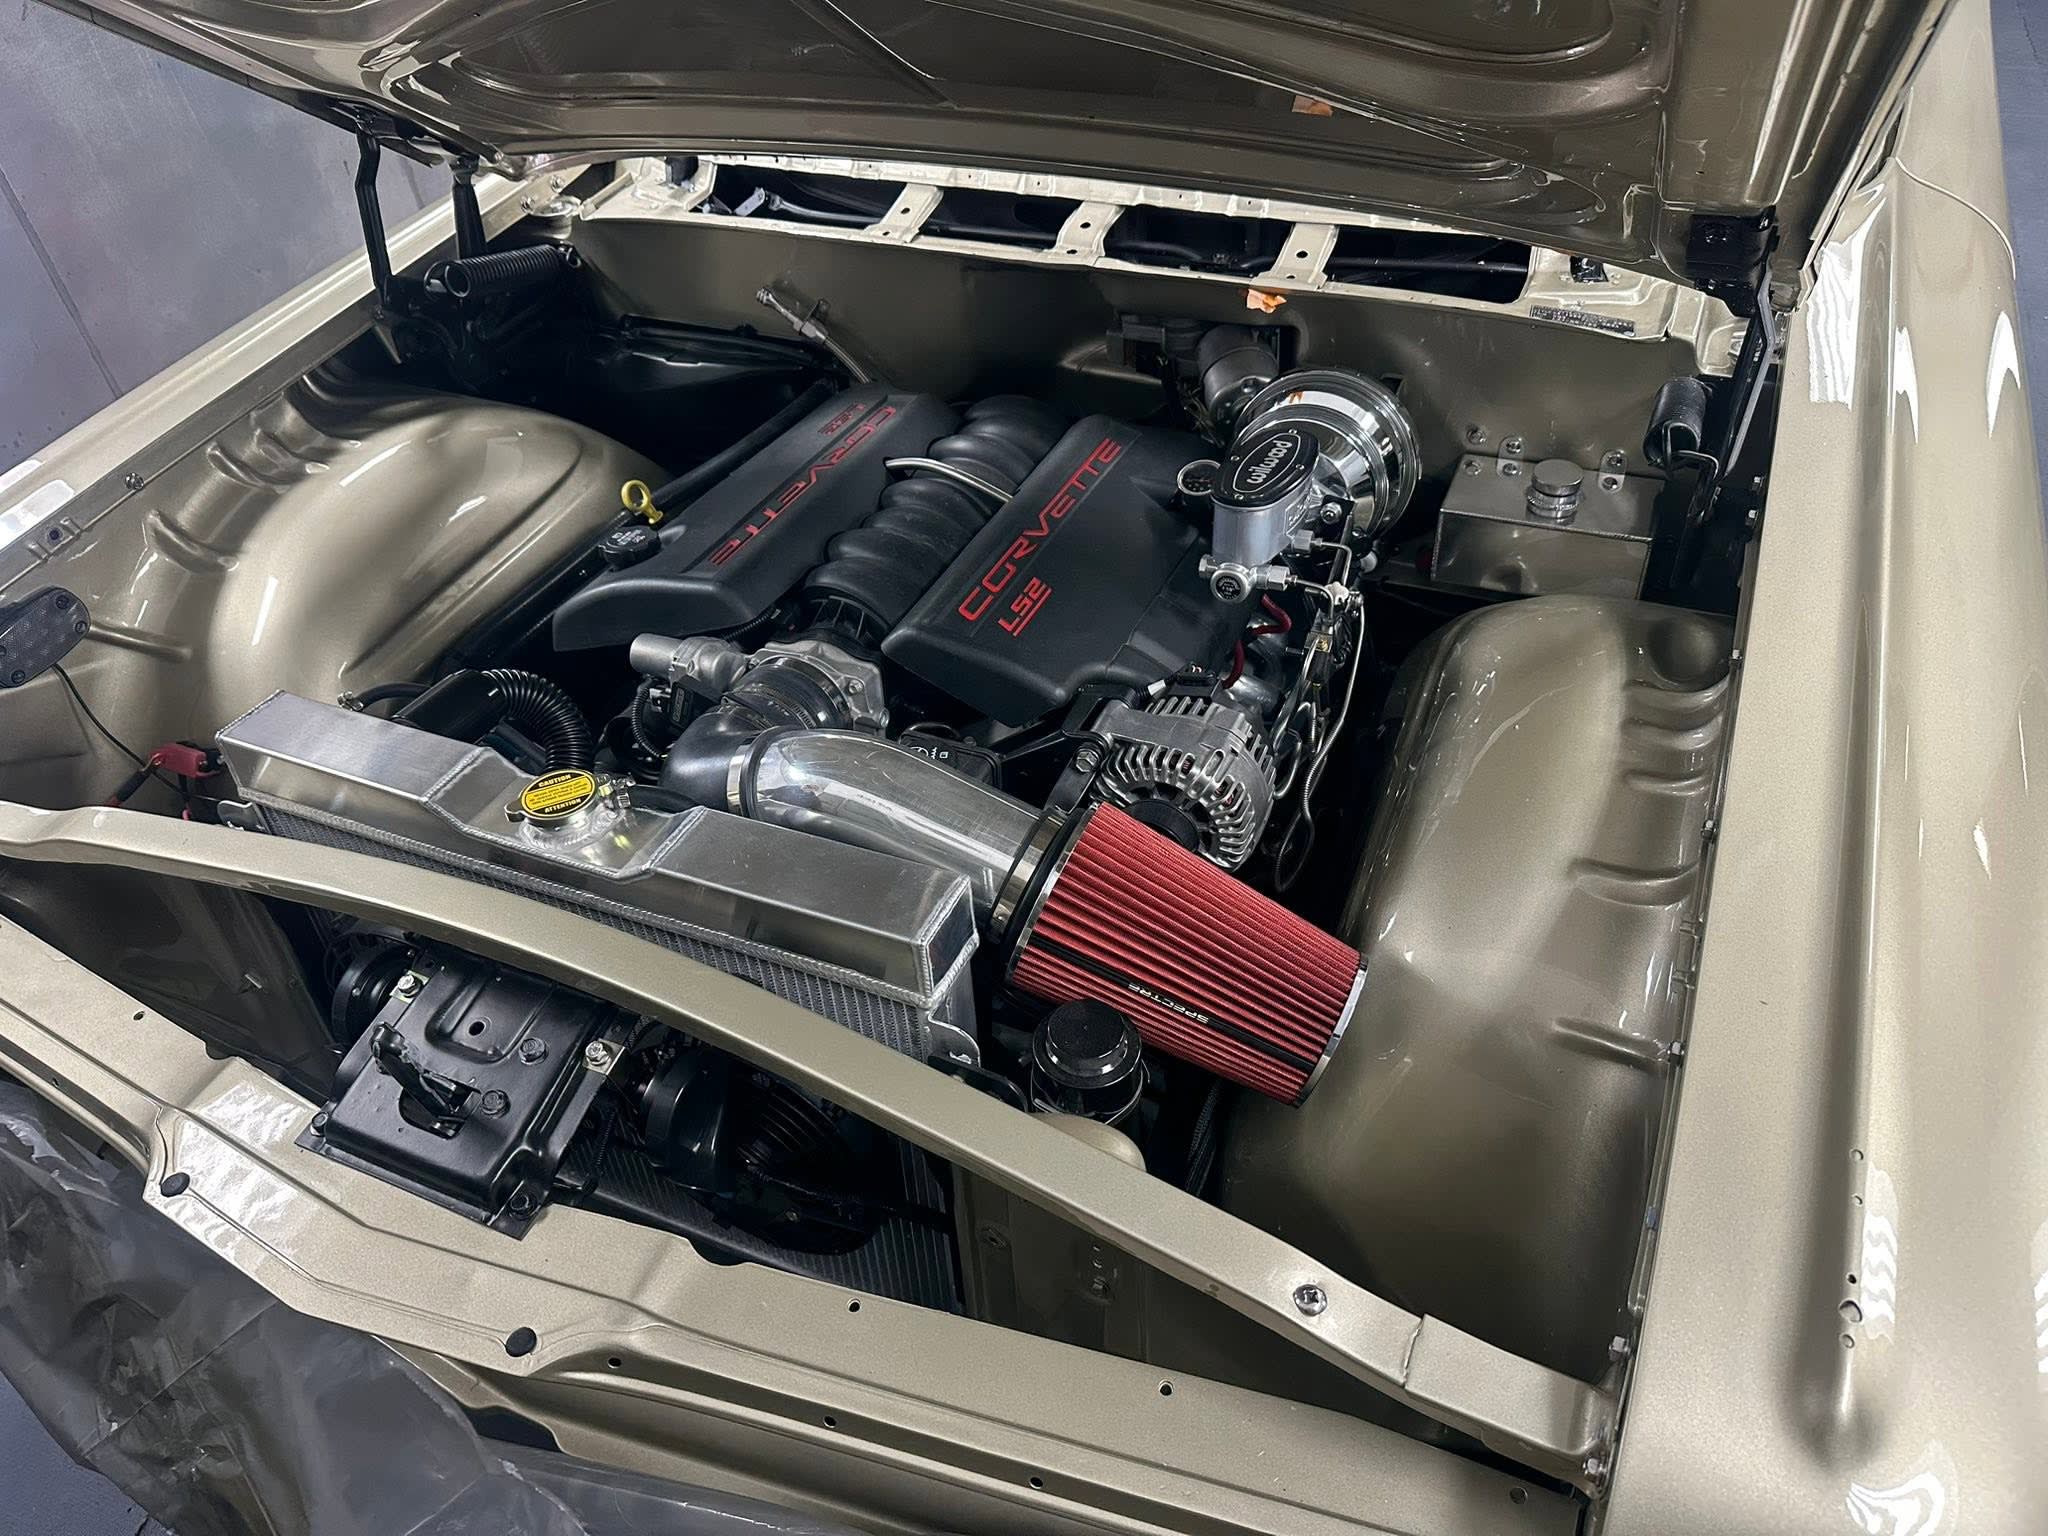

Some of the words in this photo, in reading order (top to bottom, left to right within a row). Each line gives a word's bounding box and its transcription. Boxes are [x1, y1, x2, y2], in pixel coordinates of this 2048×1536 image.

[1246, 440, 1293, 484] wilwood
[708, 406, 896, 566] CORVETTE
[958, 437, 1121, 621] CORVETTE
[997, 576, 1052, 636] LS2
[538, 774, 572, 788] CAUTION
[544, 798, 582, 814] ATTENTION
[1127, 982, 1209, 1024] SPECTRE
